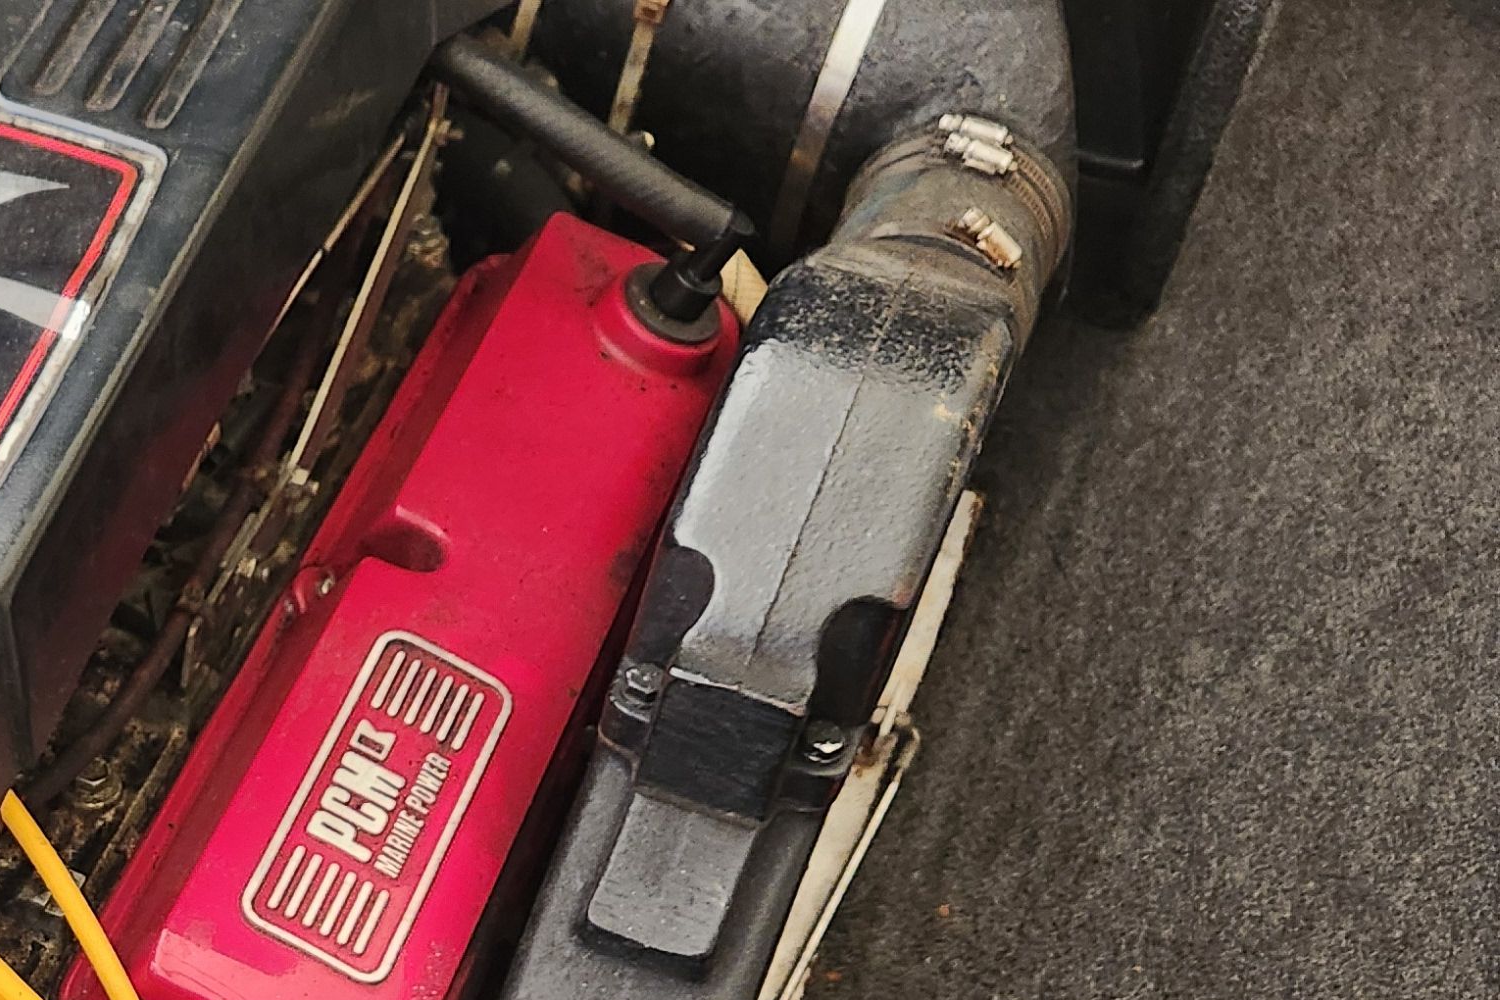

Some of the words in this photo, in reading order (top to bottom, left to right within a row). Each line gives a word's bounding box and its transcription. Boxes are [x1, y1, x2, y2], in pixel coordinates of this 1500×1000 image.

[305, 750, 407, 861] PCM
[373, 810, 422, 879] MARINE
[405, 752, 453, 820] POWER
